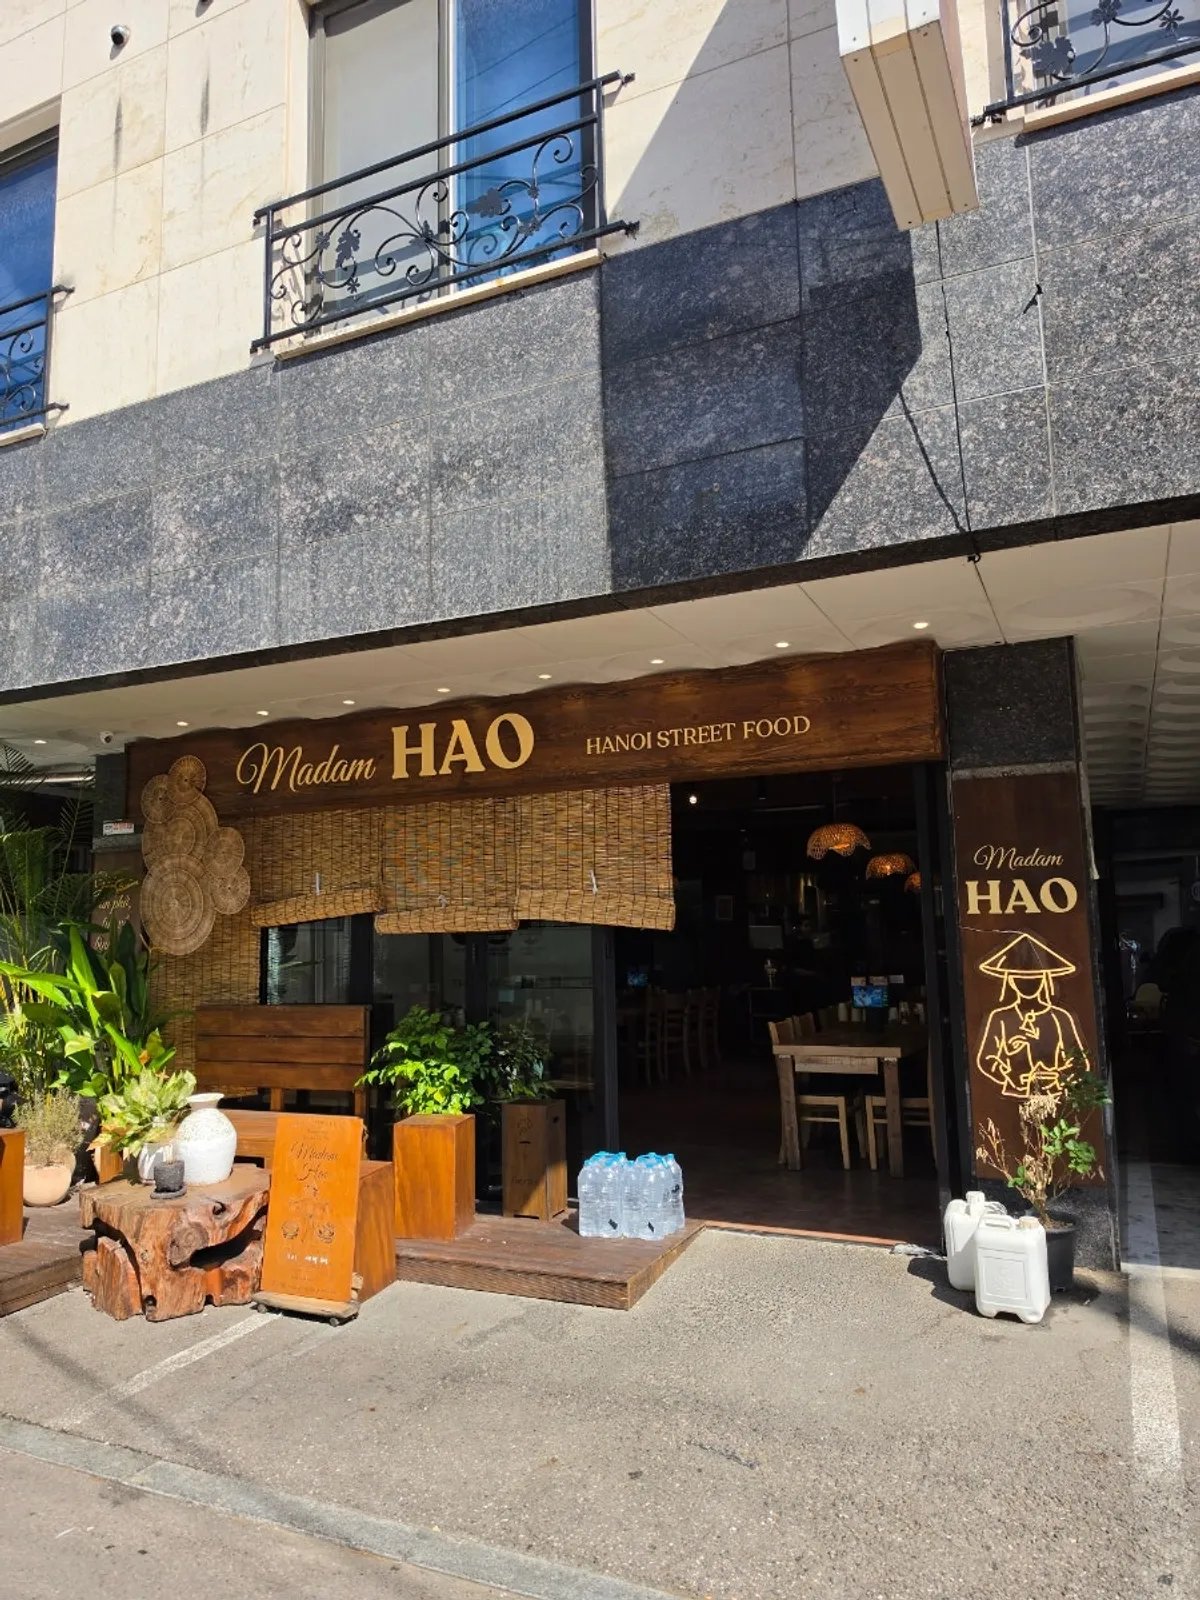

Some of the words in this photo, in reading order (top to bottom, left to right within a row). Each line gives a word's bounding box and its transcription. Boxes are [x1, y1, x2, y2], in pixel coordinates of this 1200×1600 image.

[236, 743, 376, 794] Madam
[391, 713, 535, 779] HAO
[586, 732, 652, 755] HANOI
[656, 722, 736, 748] STREET
[743, 715, 811, 739] FOOD
[973, 844, 1064, 871] Madam
[965, 877, 1078, 914] HAO
